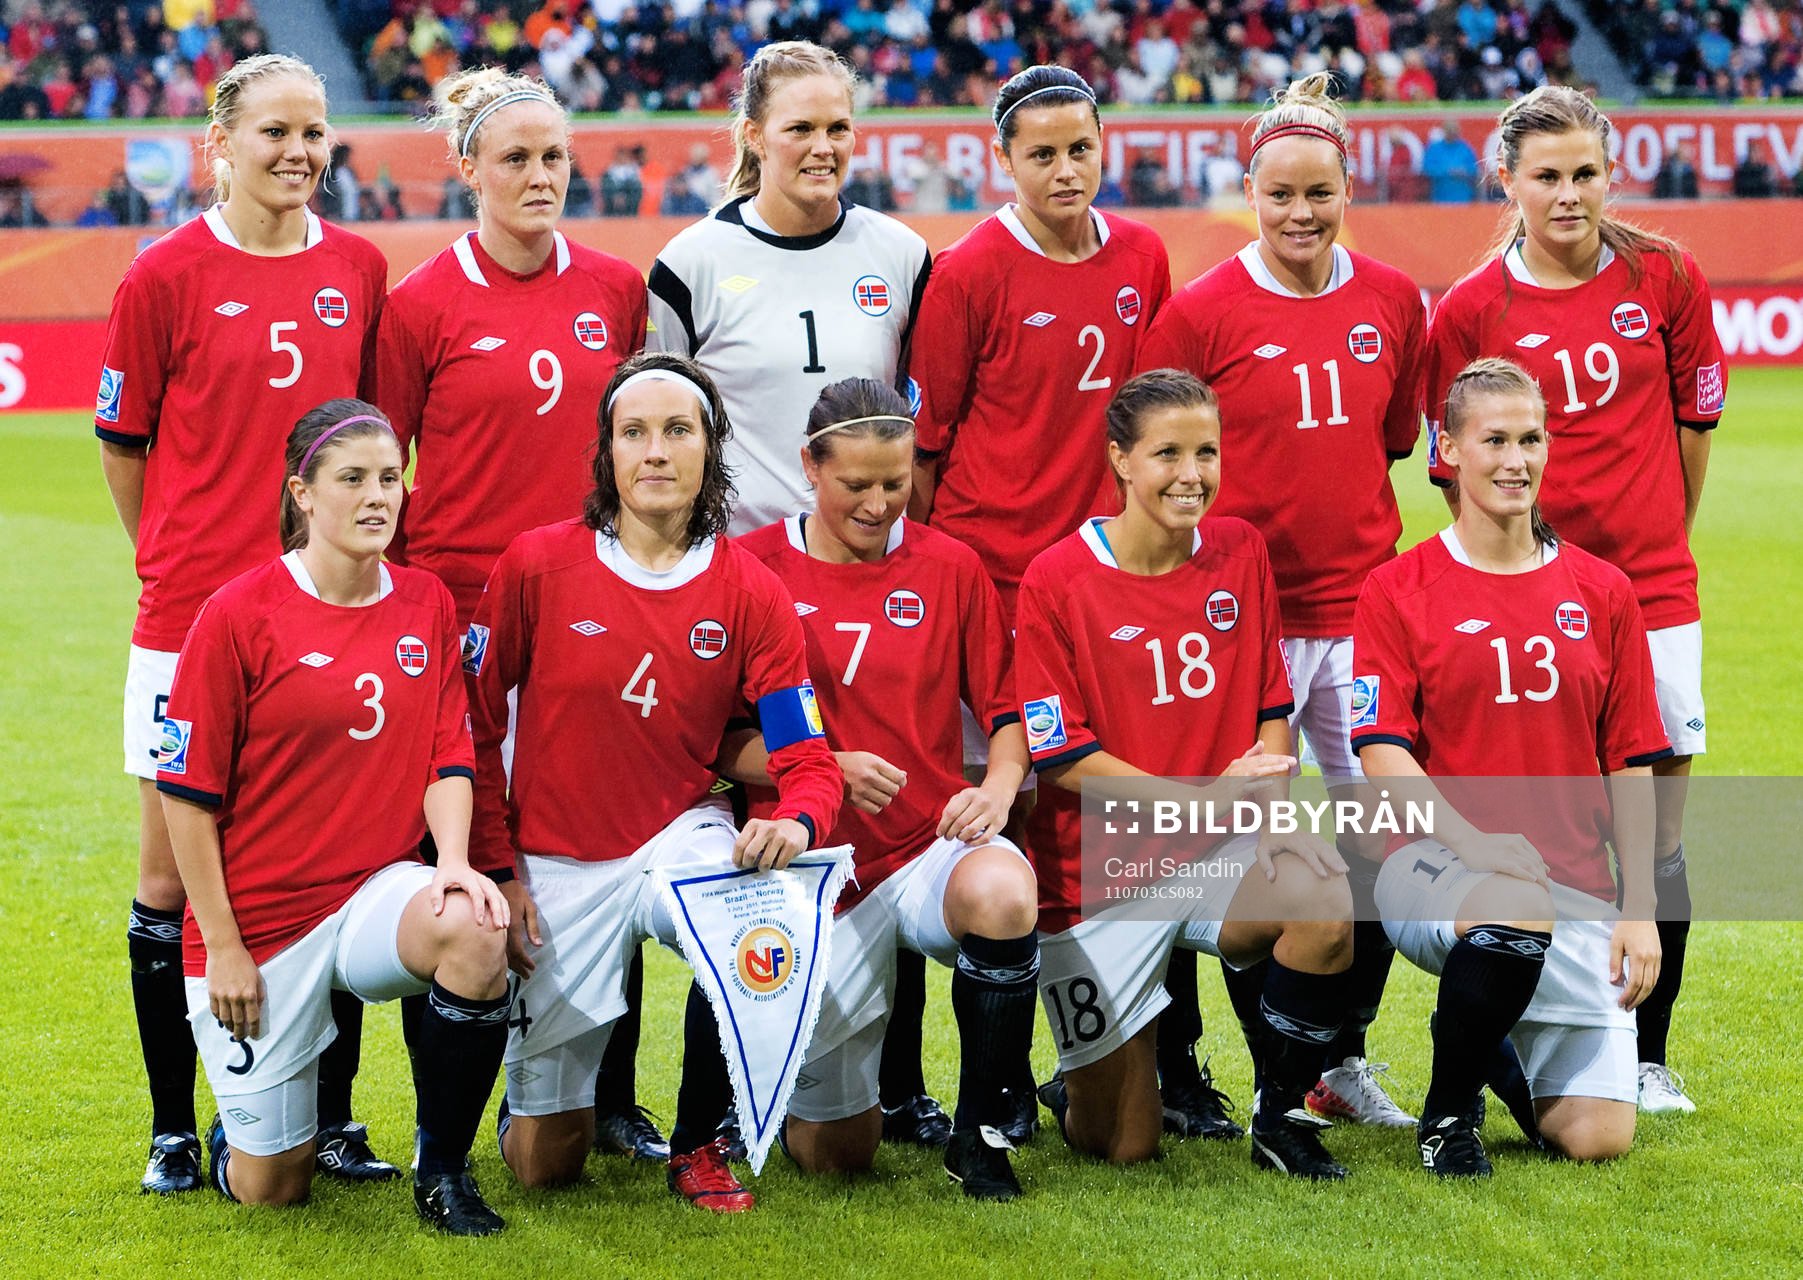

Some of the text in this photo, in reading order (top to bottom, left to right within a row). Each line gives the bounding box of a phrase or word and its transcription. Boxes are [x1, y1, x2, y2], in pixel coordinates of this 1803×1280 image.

[268, 320, 303, 389] 5
[799, 310, 826, 374] 1
[1077, 324, 1112, 391] 2
[528, 349, 564, 416] 9
[1293, 359, 1349, 430] 11
[1553, 341, 1620, 414] 19
[621, 652, 659, 718] 4
[834, 621, 872, 686] 7
[1146, 631, 1216, 706] 18
[1490, 635, 1560, 704] 13
[348, 672, 386, 741] 3
[724, 893, 748, 904] Brazil
[756, 888, 784, 898] Norway
[754, 985, 788, 1002] ASSOCIATION
[1048, 977, 1106, 1050] 18
